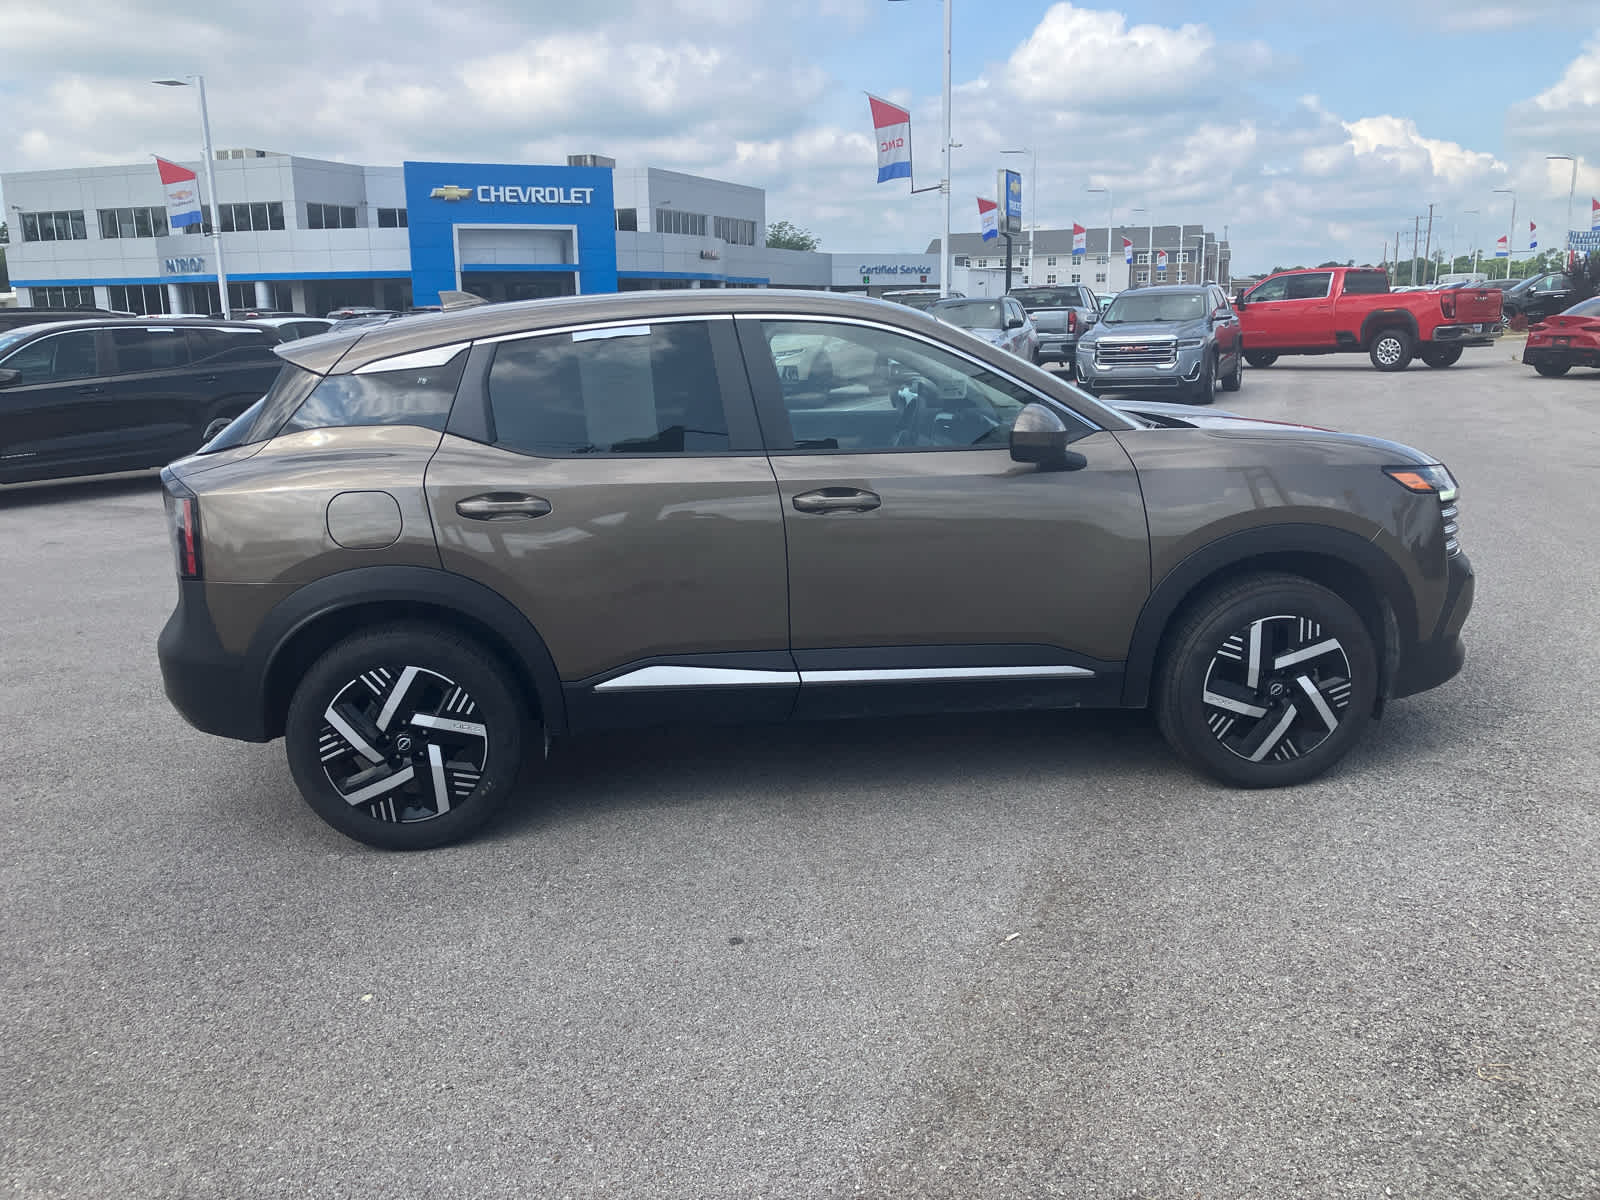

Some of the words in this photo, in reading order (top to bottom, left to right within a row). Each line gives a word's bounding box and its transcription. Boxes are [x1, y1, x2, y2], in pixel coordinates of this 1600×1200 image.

[477, 185, 594, 204] CHEVROLET
[859, 264, 898, 274] Certified
[900, 264, 931, 274] Service
